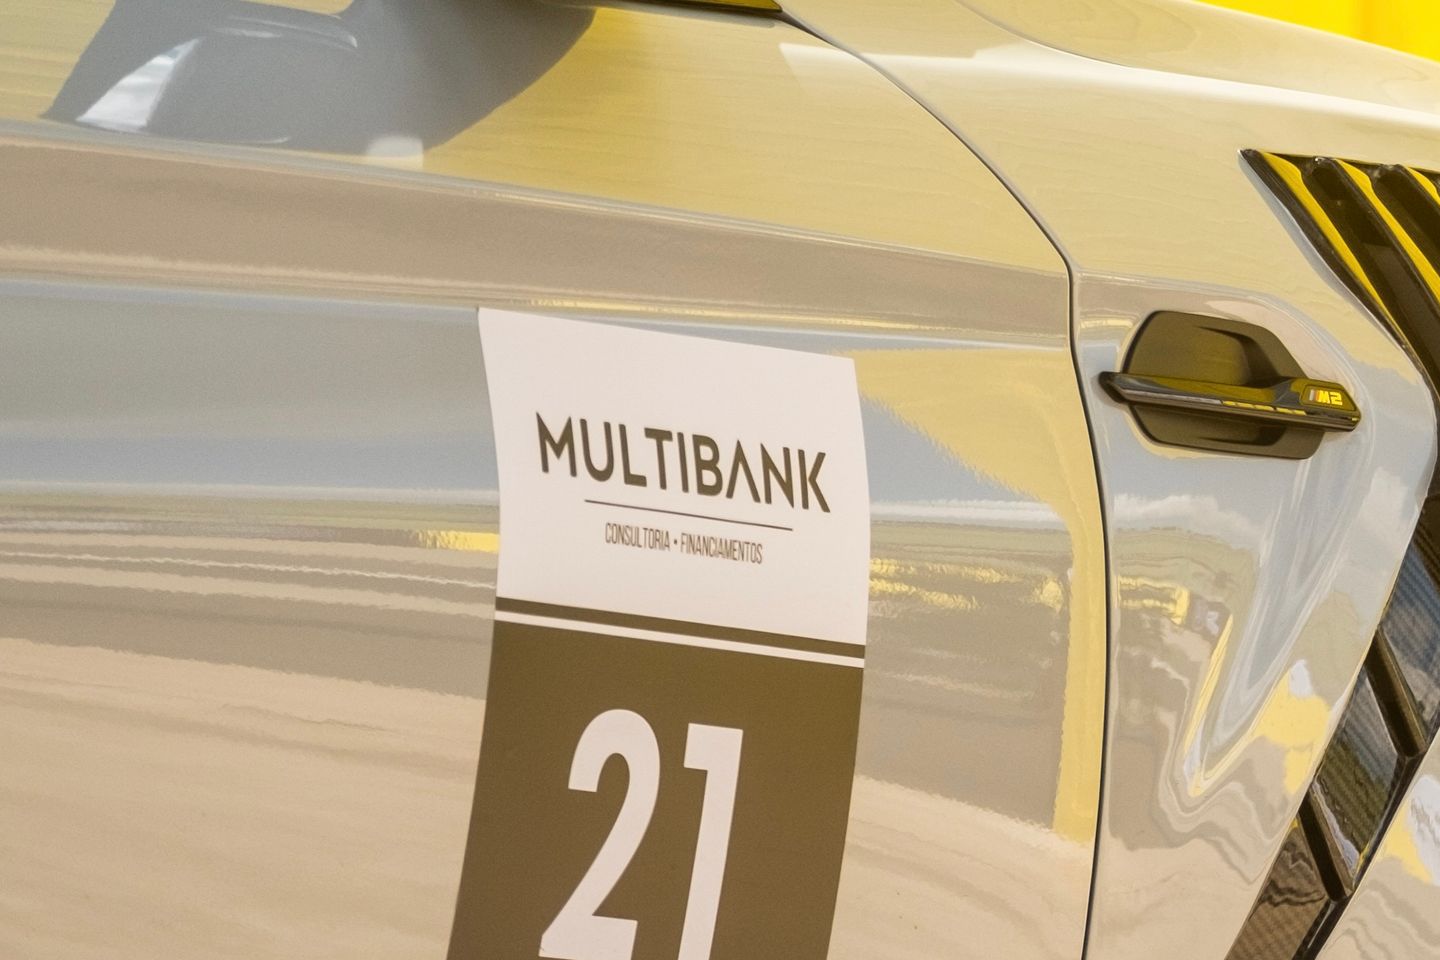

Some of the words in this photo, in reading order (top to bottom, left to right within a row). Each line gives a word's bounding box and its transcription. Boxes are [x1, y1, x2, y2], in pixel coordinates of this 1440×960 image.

[1317, 389, 1343, 406] M2
[536, 411, 831, 513] MULTIBANK
[605, 522, 670, 551] CONSULTORIA
[680, 532, 763, 564] FINANCIAMENTOS
